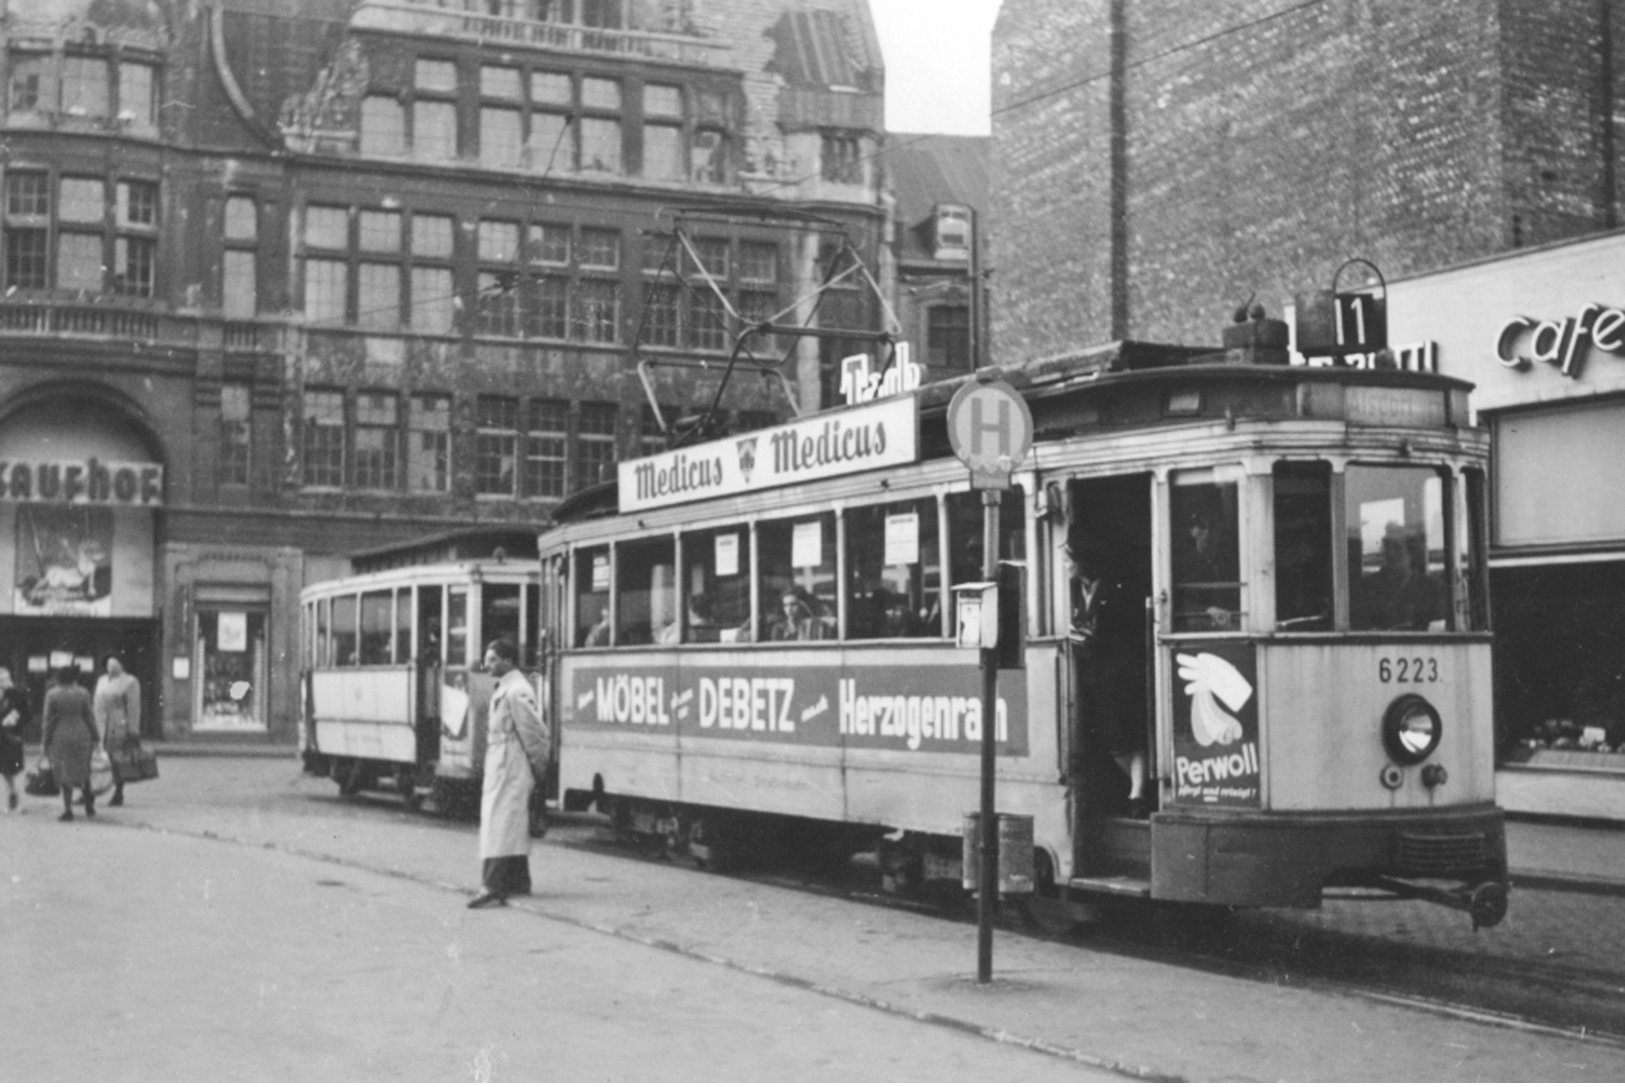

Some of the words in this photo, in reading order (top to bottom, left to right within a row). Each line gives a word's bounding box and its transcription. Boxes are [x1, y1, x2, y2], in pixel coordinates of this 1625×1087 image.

[635, 454, 723, 500] Medicus
[771, 420, 886, 473] Medicus
[971, 397, 1010, 458] H
[597, 674, 670, 725] MÖBEL
[700, 677, 796, 732] DEBETZ
[839, 678, 1008, 750] Herzogenrah
[1176, 742, 1258, 786] Perwoll
